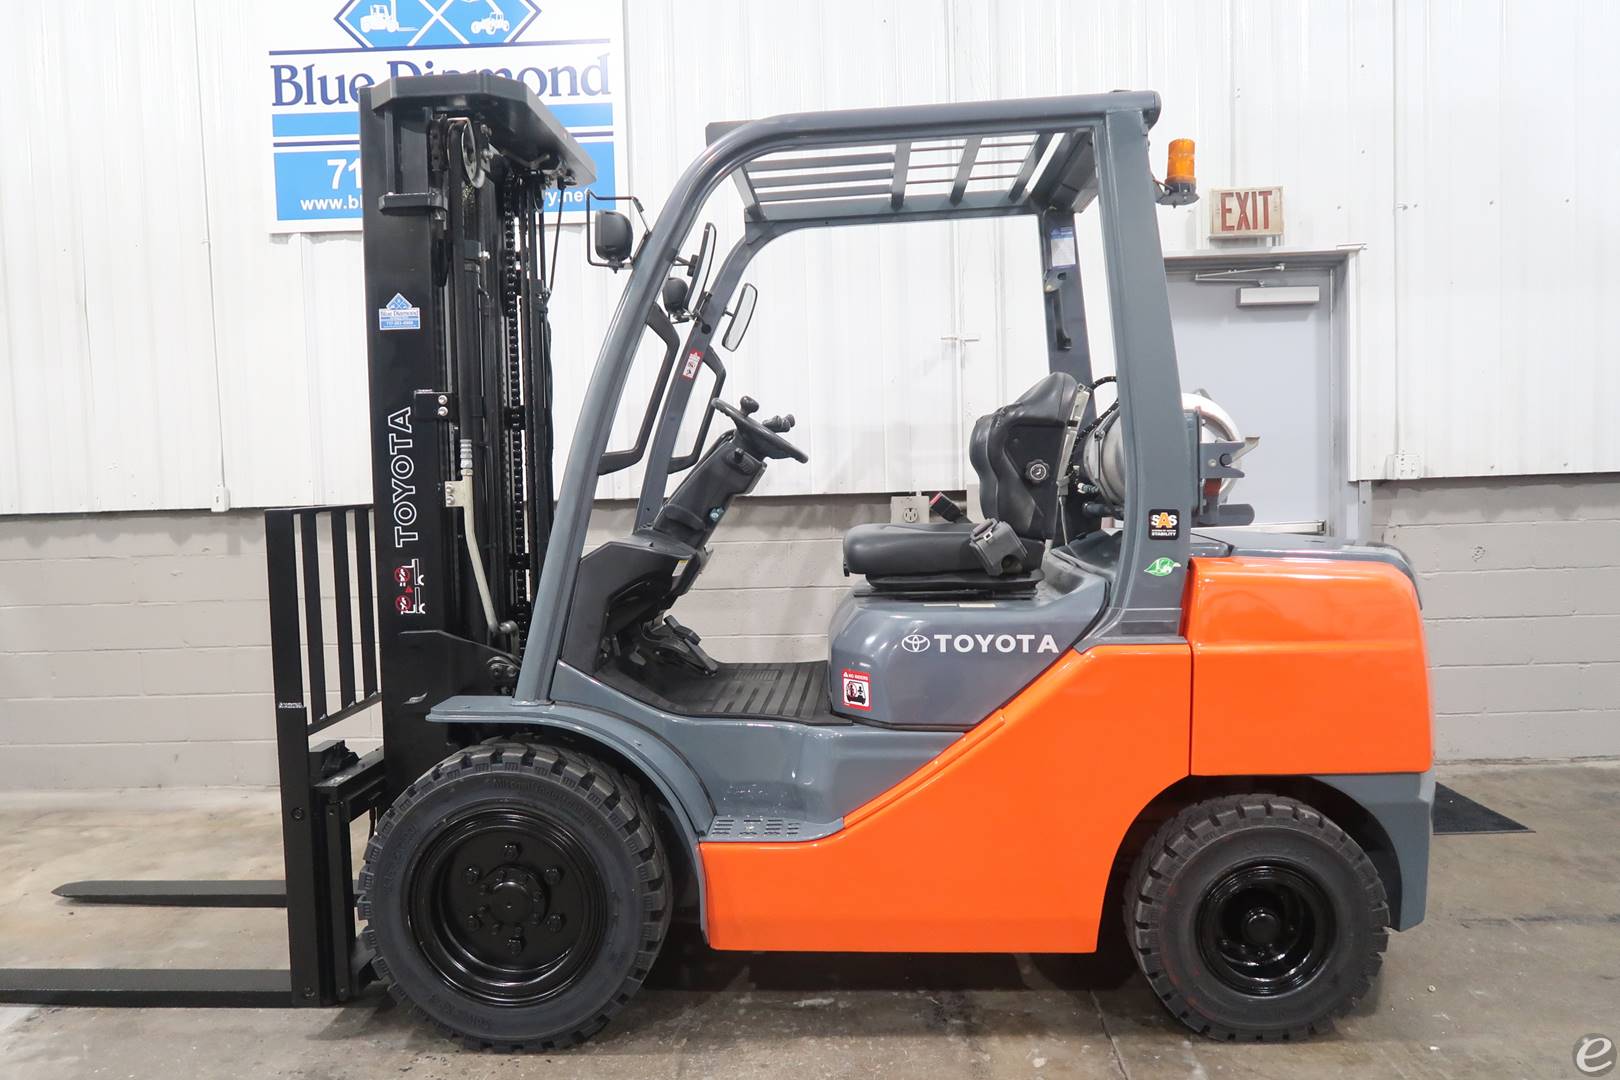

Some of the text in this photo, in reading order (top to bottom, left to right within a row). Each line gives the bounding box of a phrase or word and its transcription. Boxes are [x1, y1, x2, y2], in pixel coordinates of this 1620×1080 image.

[270, 64, 375, 106] Blue
[1220, 190, 1273, 232] EXIT
[388, 406, 419, 548] TOYOTA
[1150, 512, 1178, 529] SAS
[933, 634, 1060, 653] TOYOTA
